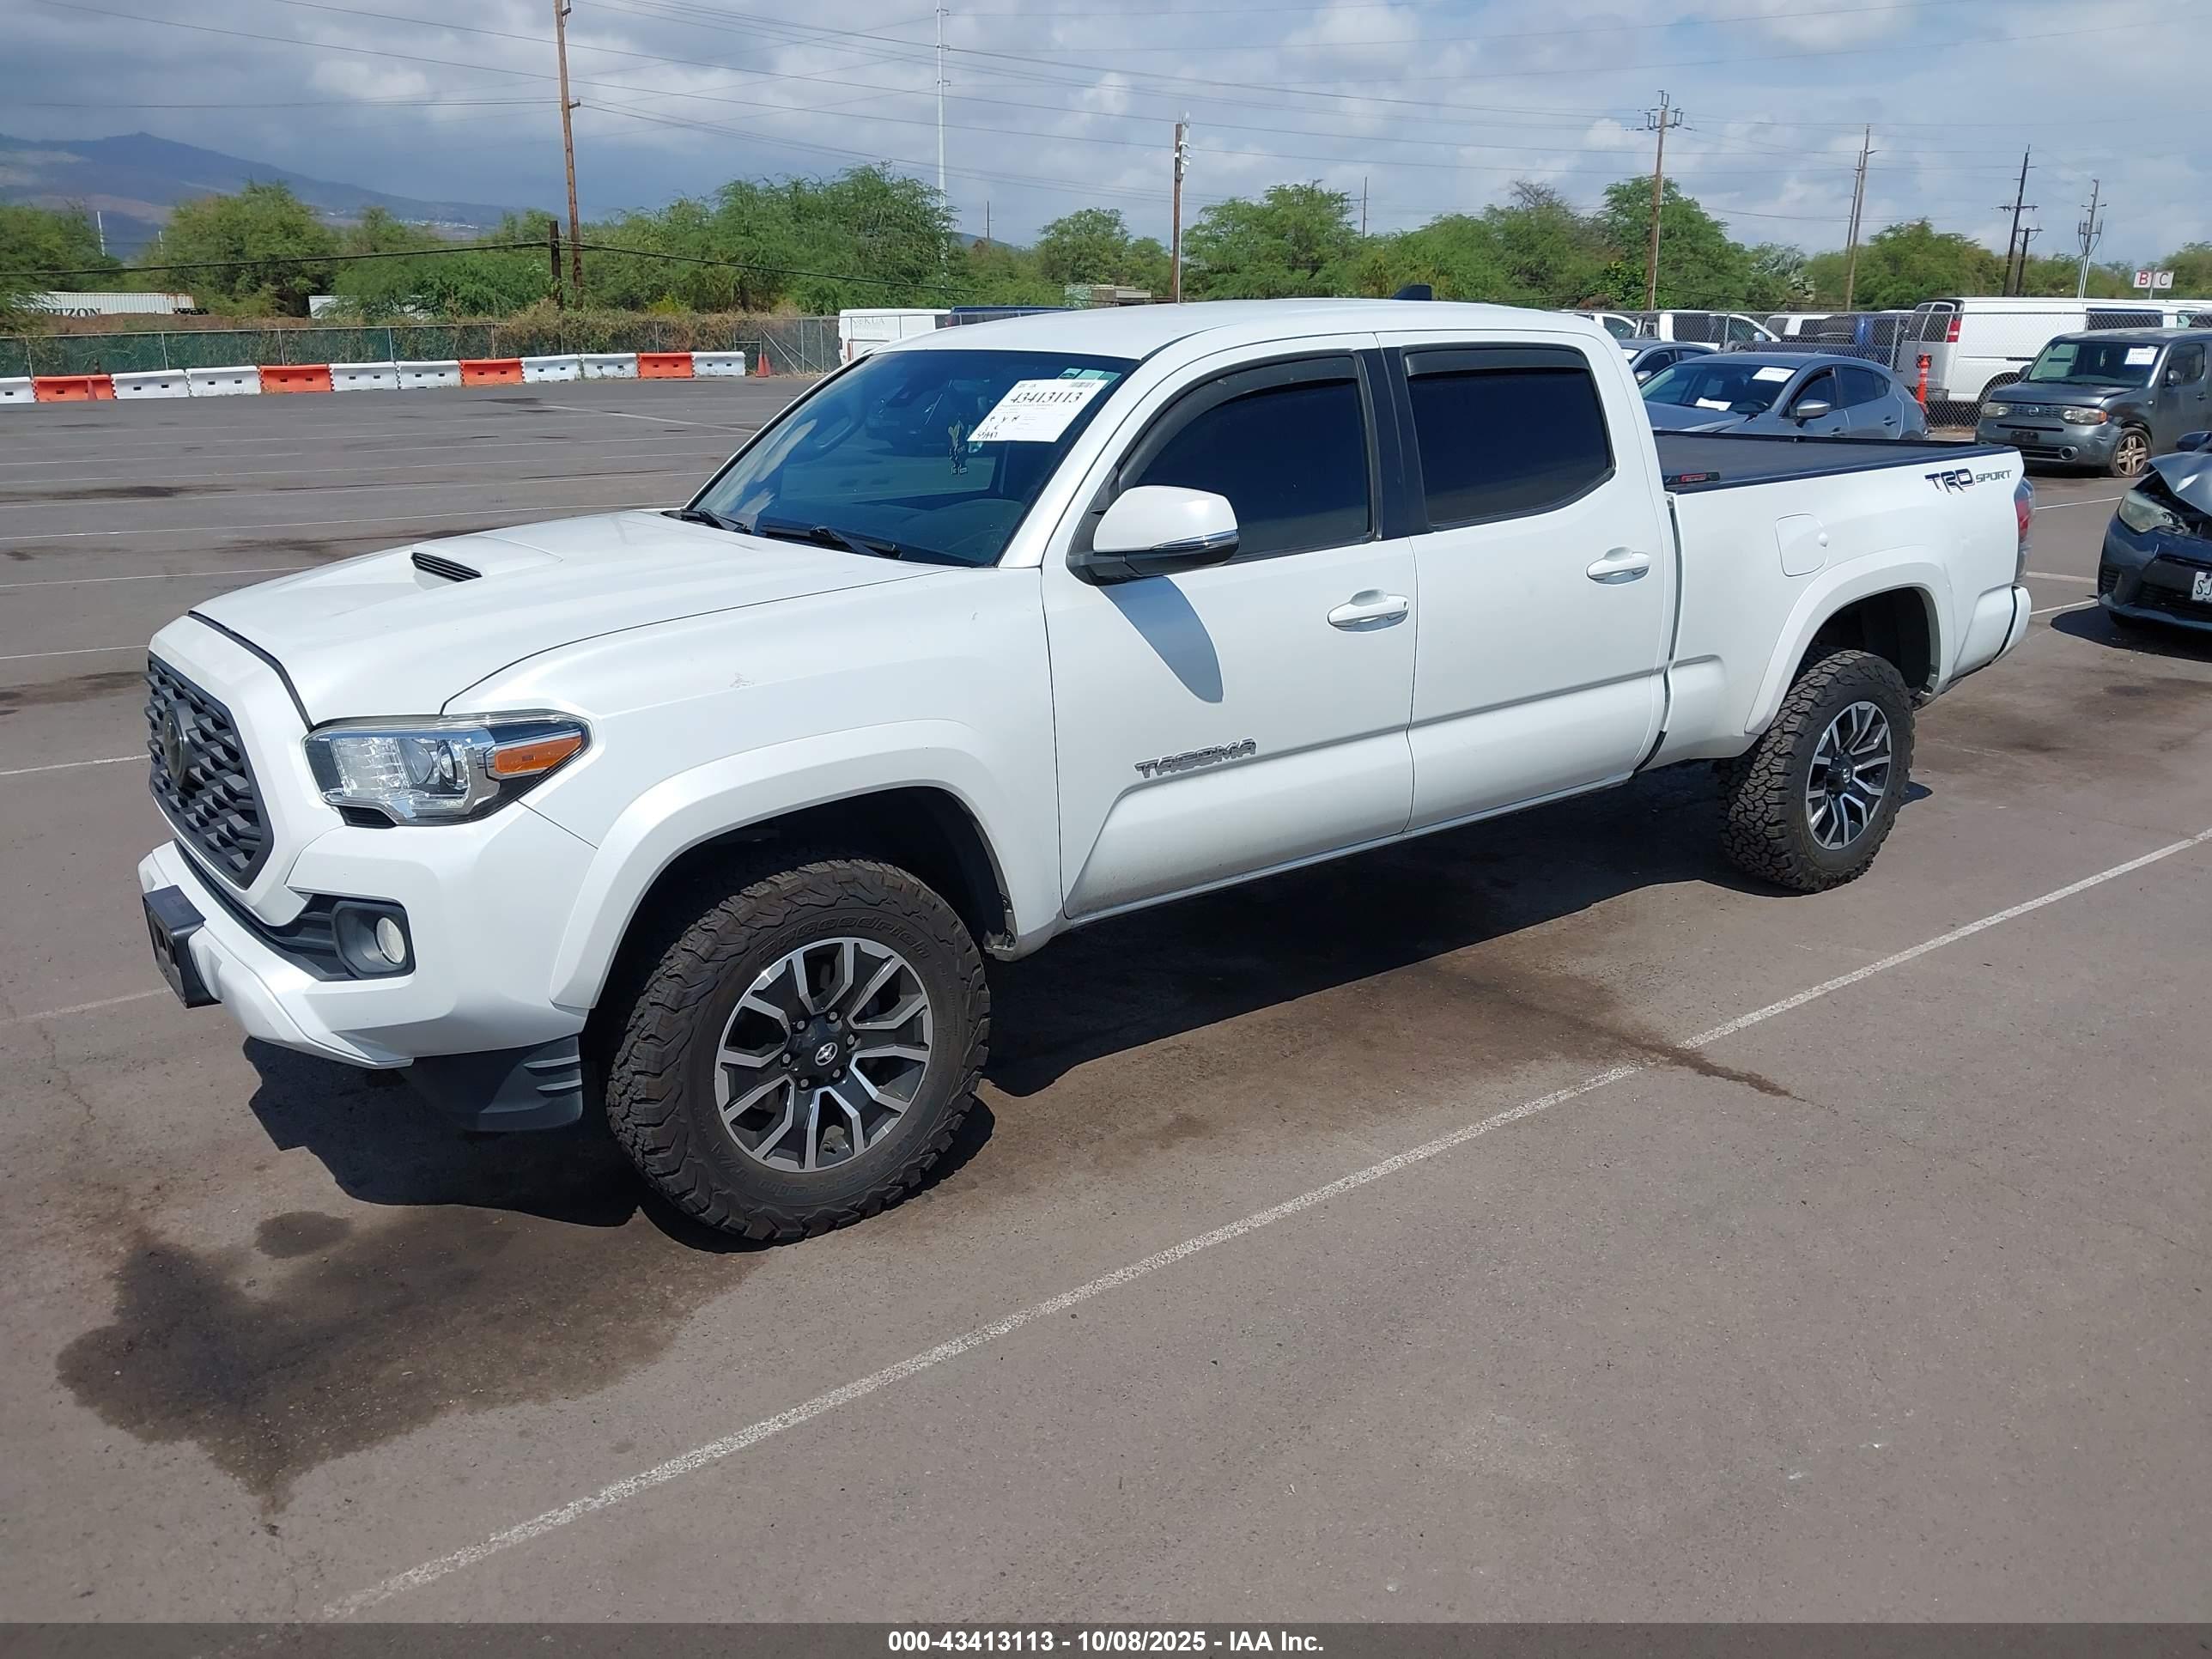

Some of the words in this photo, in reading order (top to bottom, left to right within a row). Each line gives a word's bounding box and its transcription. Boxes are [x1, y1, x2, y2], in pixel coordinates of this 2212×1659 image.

[2138, 271, 2149, 285] B
[2159, 272, 2169, 286] C
[1011, 392, 1082, 404] 43413113
[1924, 468, 1975, 495] TRD
[1976, 470, 2012, 483] SPORT
[1134, 738, 1257, 779] TACOMA
